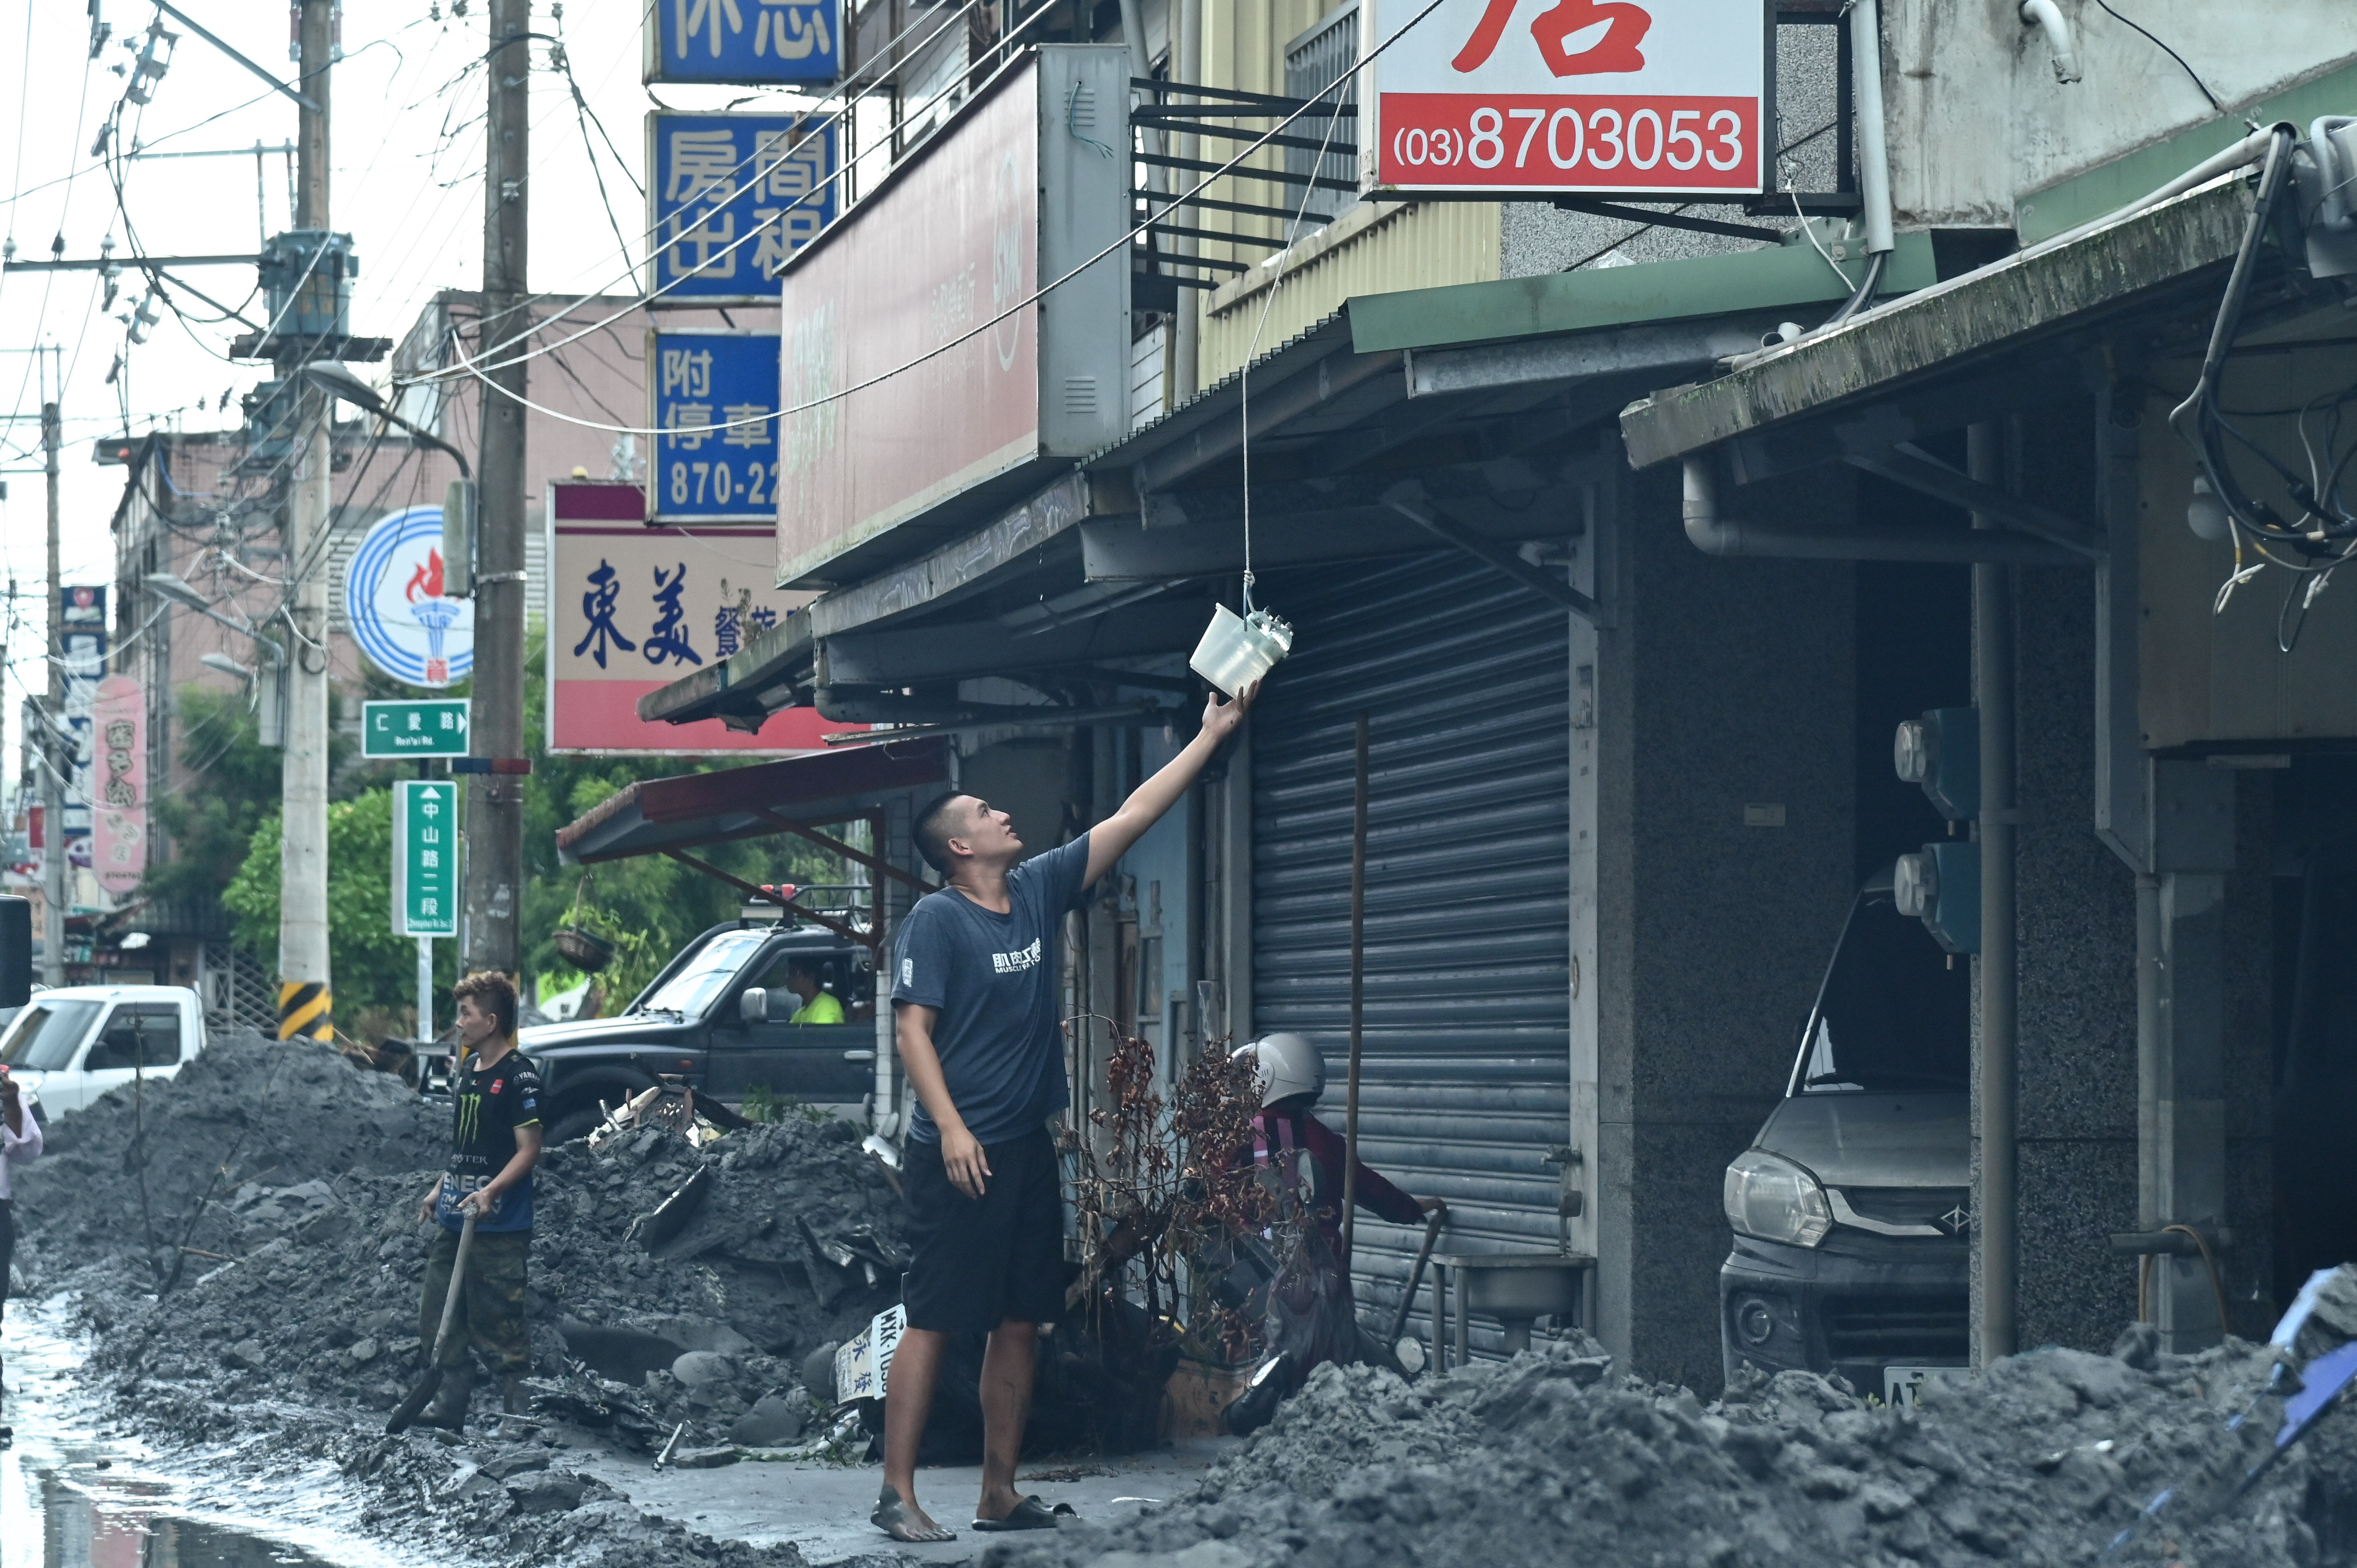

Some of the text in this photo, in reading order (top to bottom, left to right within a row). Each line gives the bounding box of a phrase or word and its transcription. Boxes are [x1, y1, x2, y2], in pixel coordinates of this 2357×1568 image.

[666, 130, 826, 206] 房間
[1393, 107, 1743, 171] (03)8703053
[376, 711, 453, 731] 仁愛路
[421, 802, 438, 916] 中山路二段
[995, 965, 1022, 974] MUSCLE
